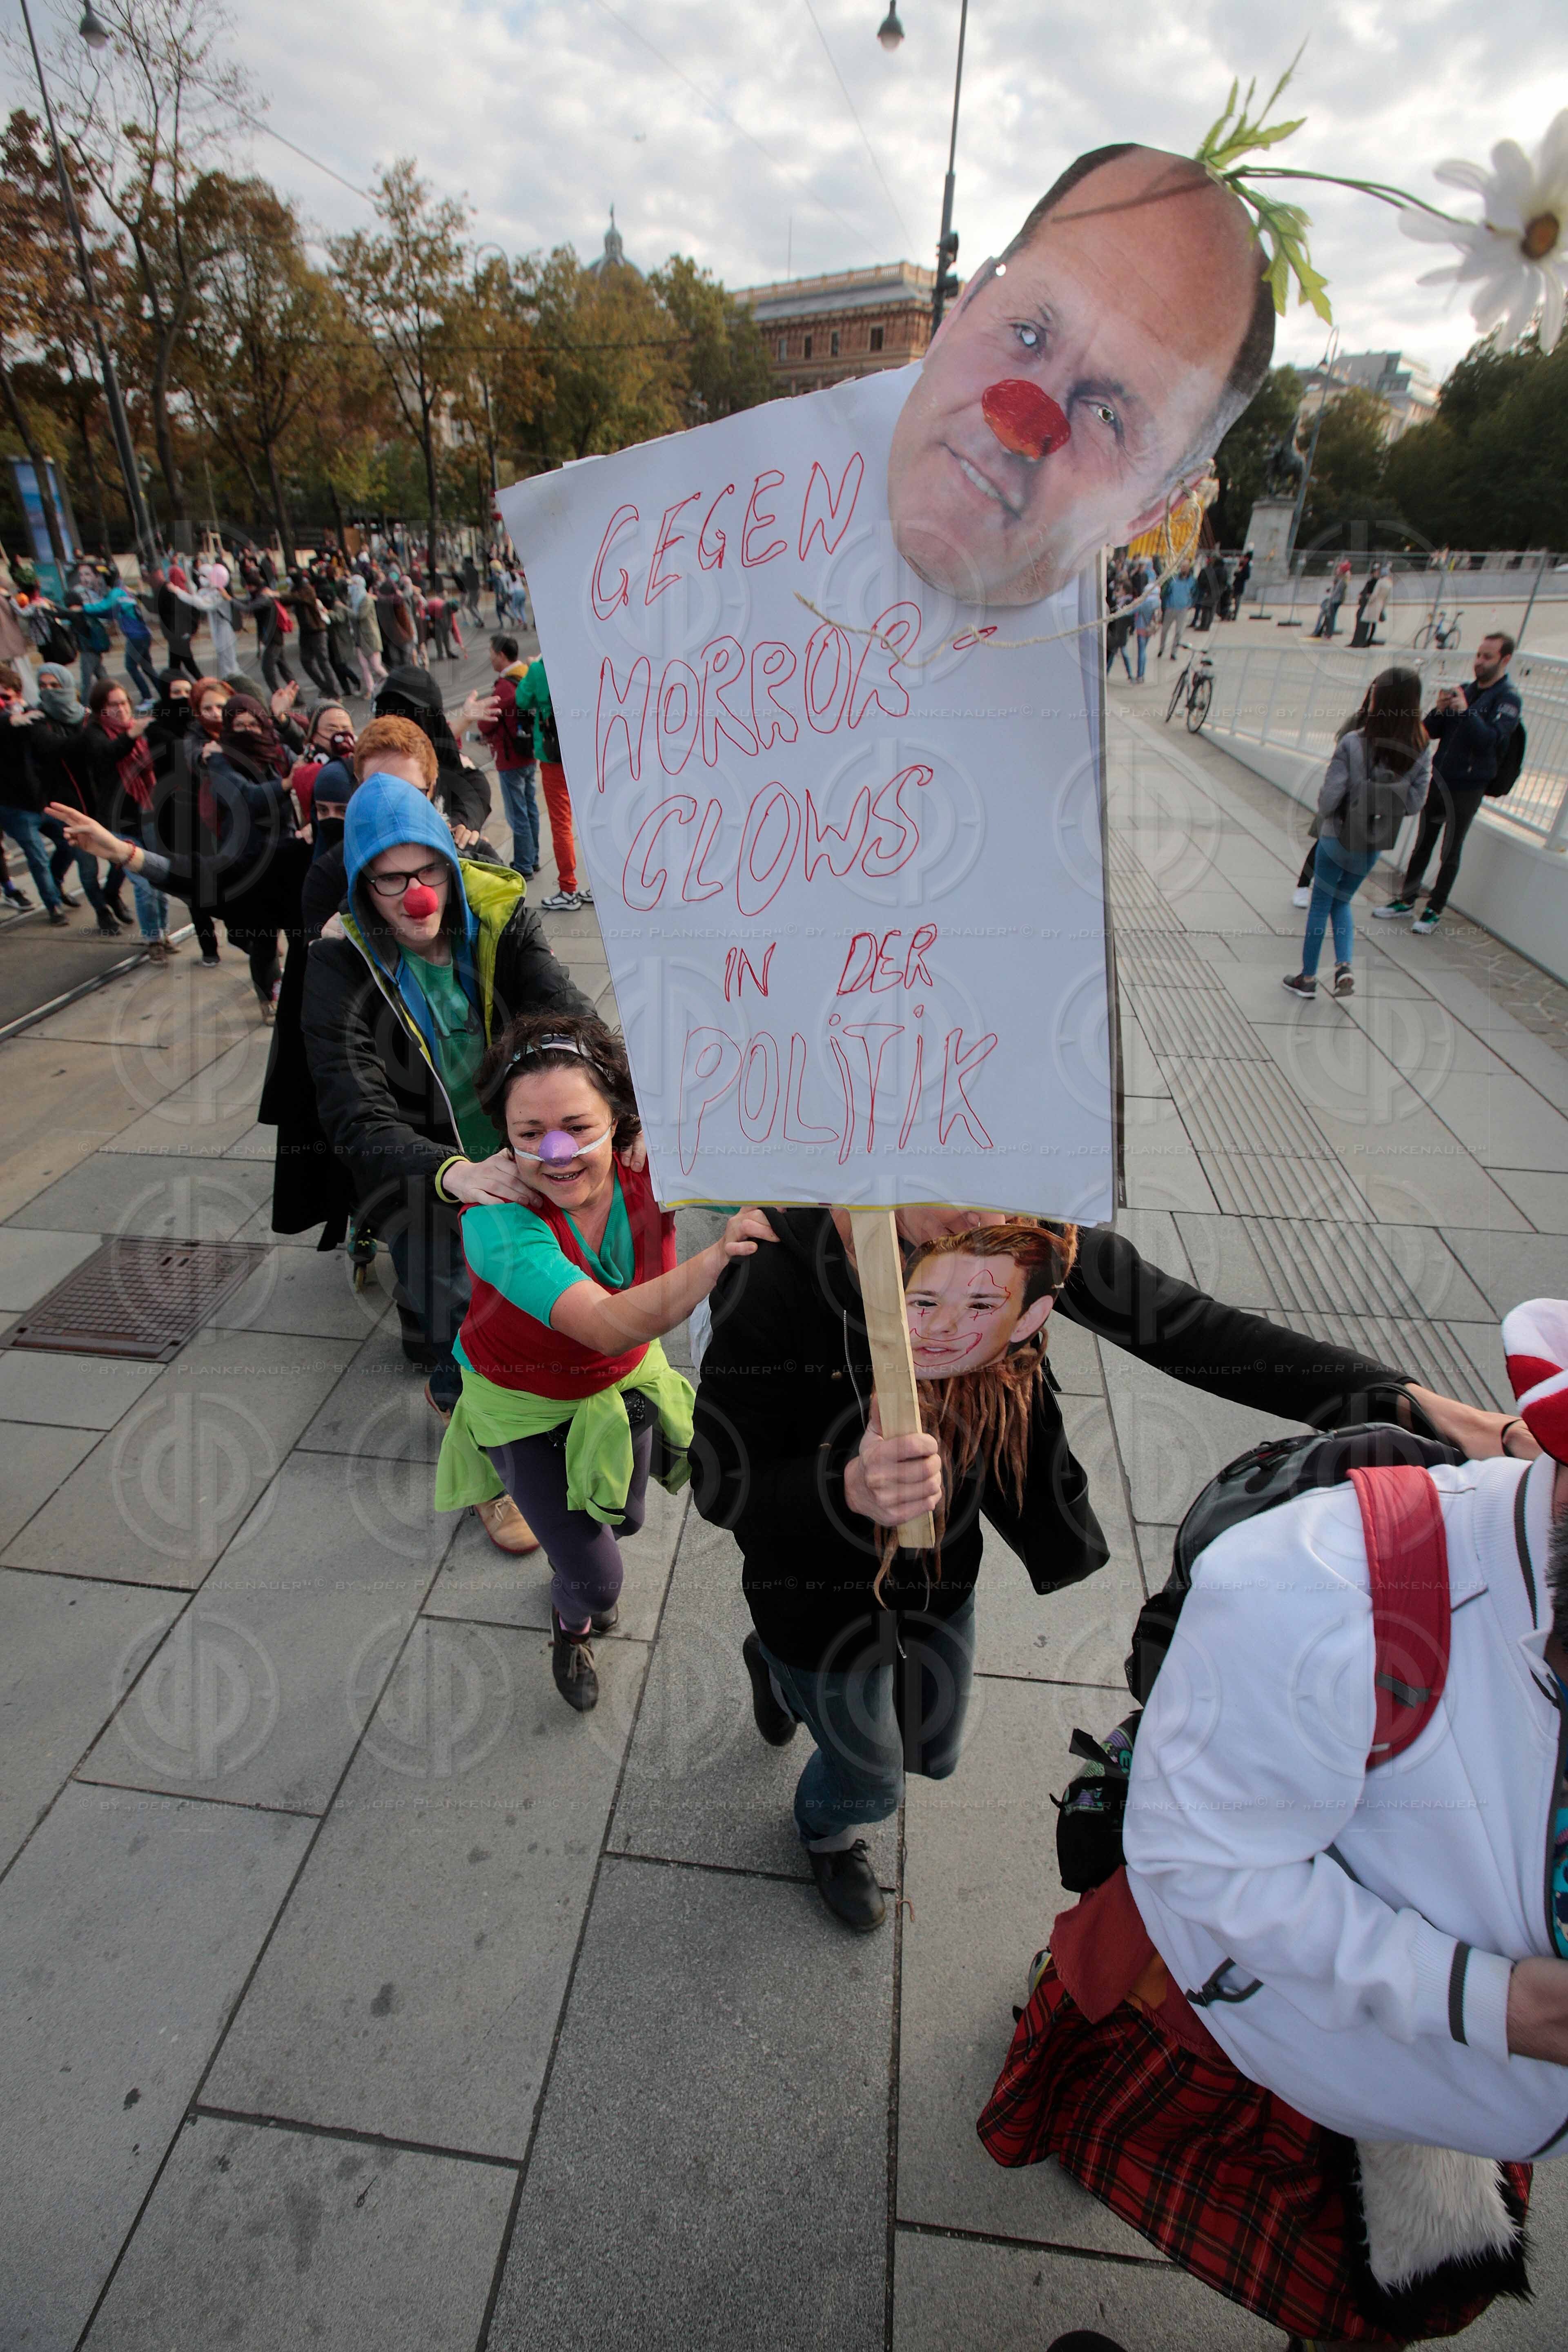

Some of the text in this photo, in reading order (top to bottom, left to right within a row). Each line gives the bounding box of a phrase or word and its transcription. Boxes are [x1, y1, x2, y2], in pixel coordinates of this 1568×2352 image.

[592, 452, 864, 621] GEGEN
[724, 923, 938, 1002] IN DER
